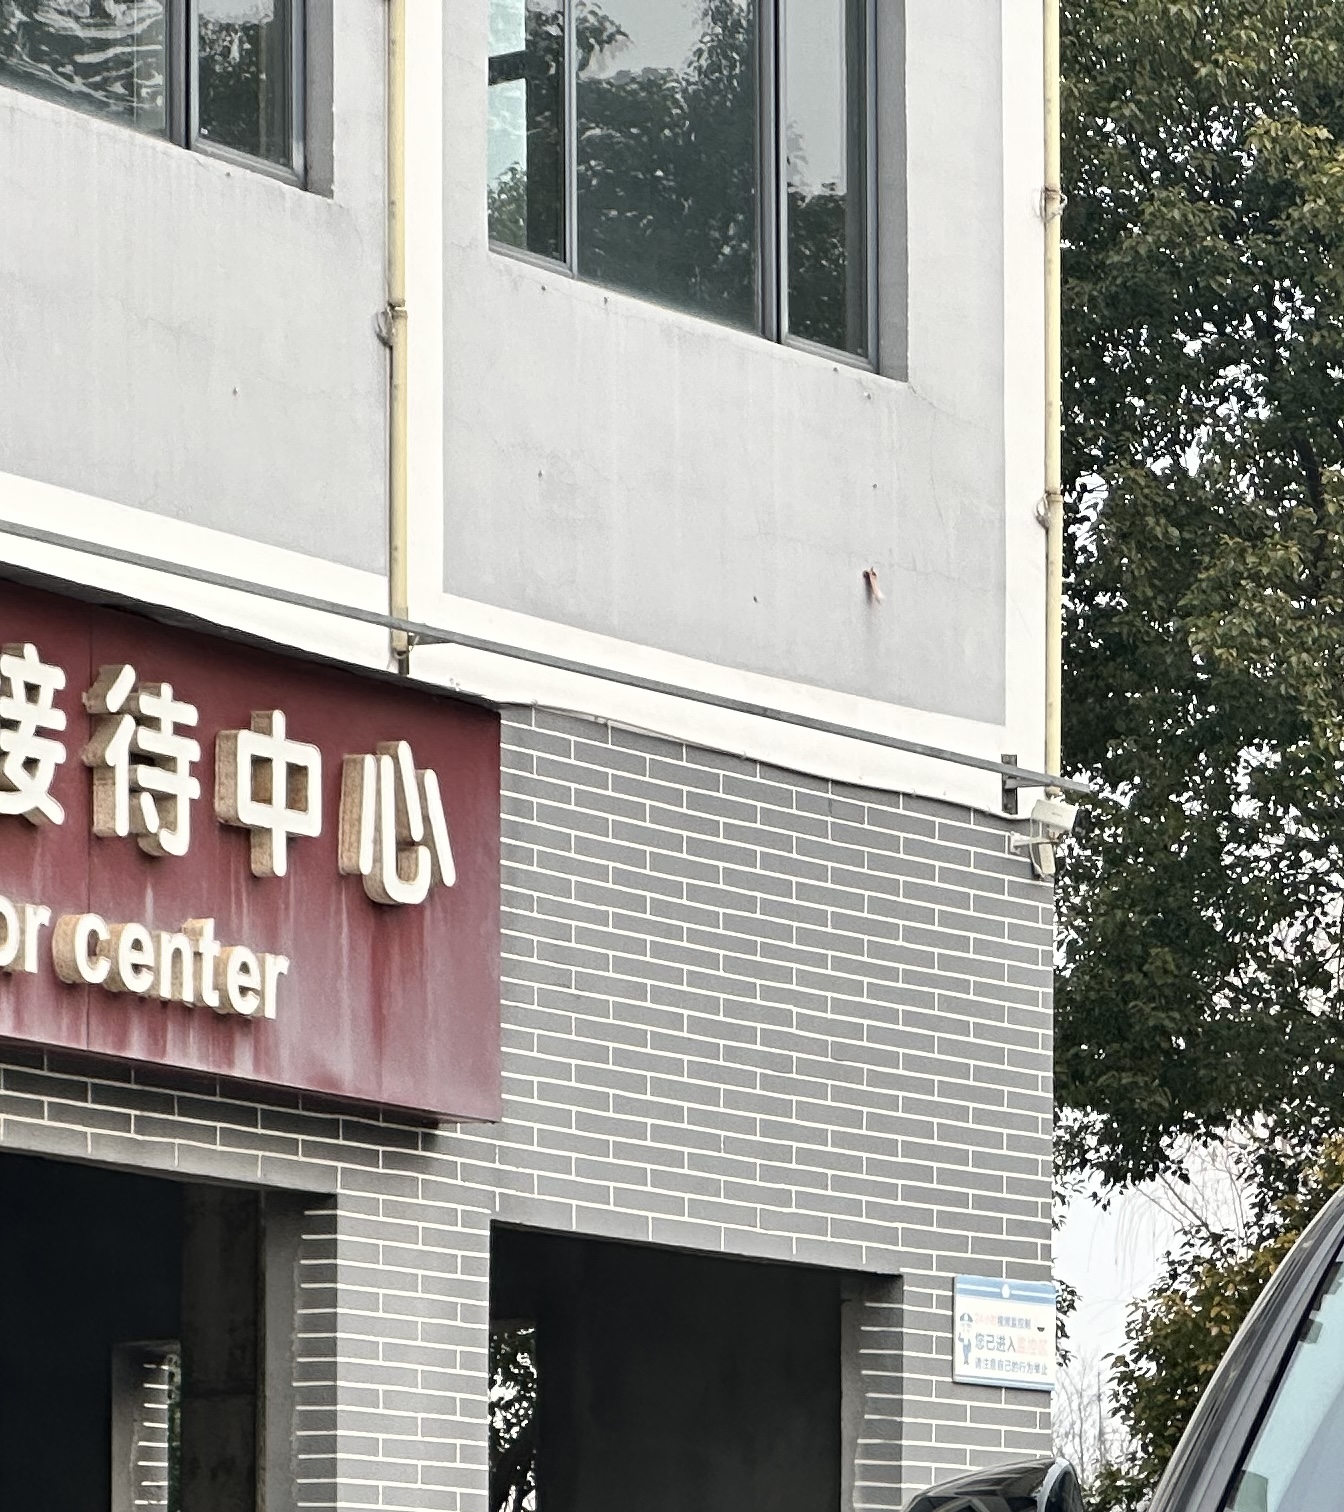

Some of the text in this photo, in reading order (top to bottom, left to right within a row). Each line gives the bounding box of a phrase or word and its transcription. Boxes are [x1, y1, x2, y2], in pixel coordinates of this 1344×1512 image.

[0, 643, 456, 904] 接待中心
[60, 912, 289, 1020] center
